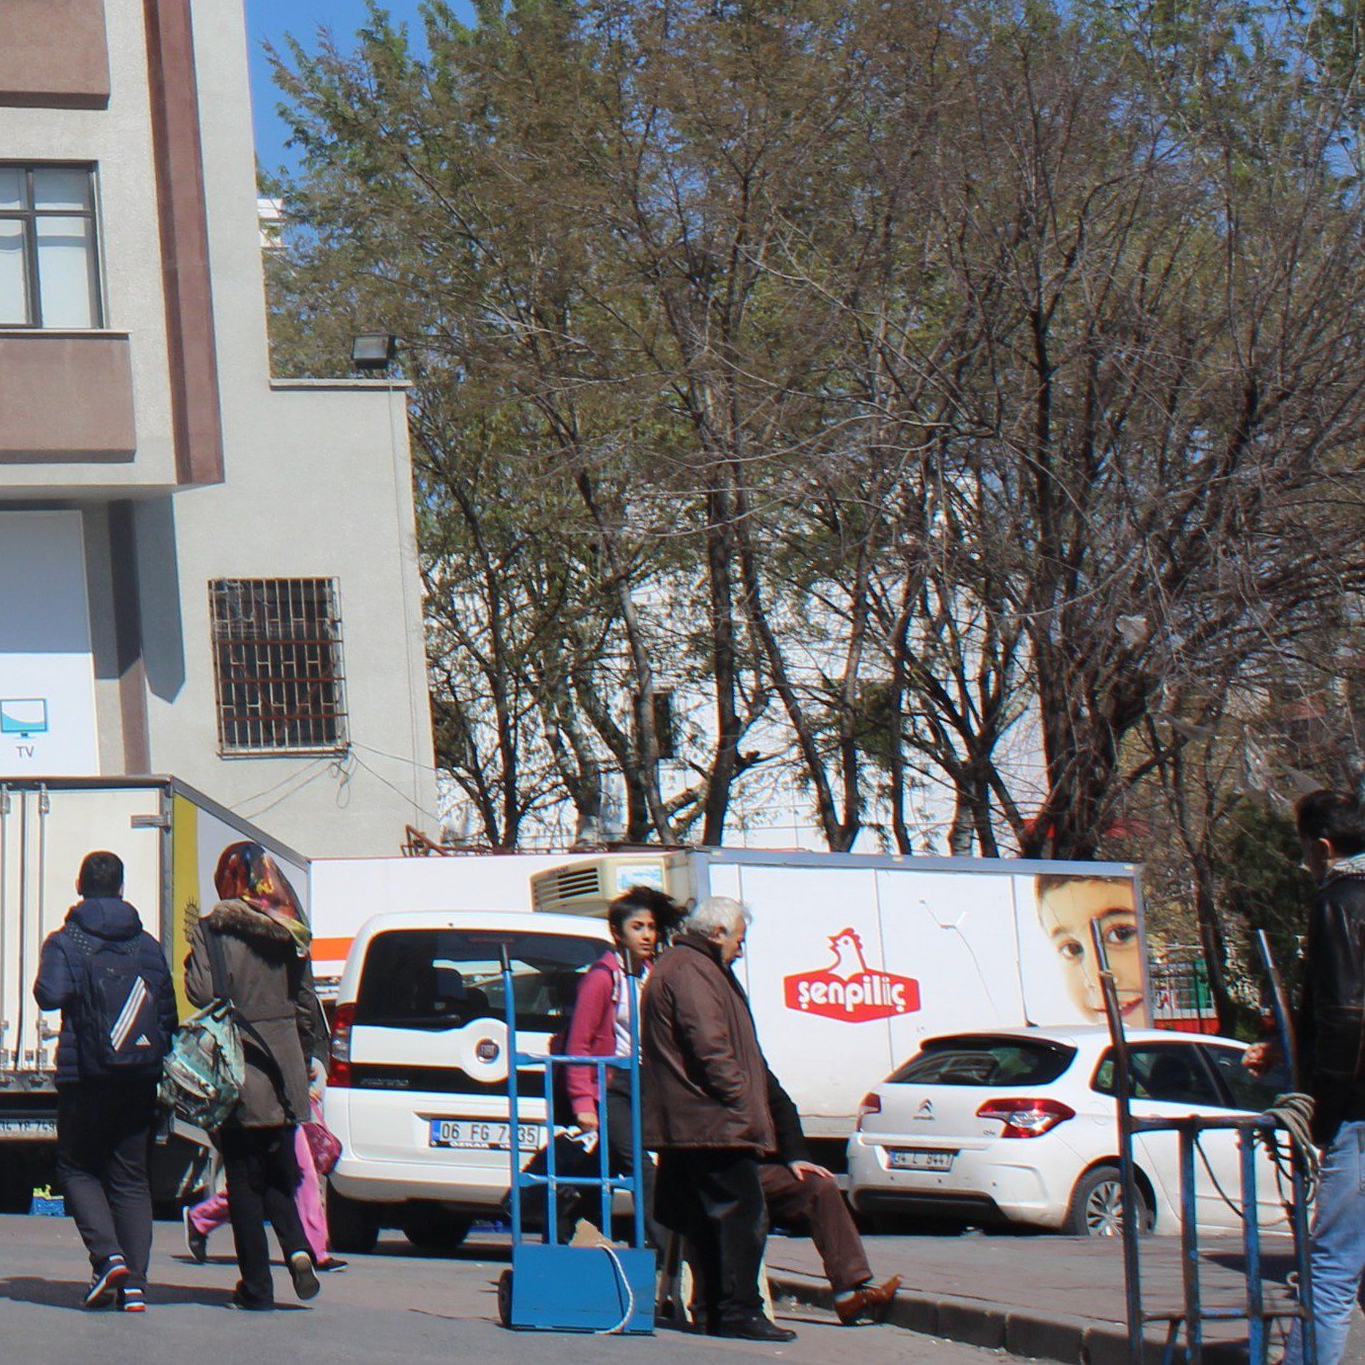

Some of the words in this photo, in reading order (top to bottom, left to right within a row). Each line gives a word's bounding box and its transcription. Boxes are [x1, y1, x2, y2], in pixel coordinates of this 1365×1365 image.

[16, 746, 34, 759] TV
[797, 975, 907, 1013] şenpiliç
[442, 1123, 460, 1140] 06
[471, 1124, 490, 1141] FG
[498, 1125, 536, 1144] 735
